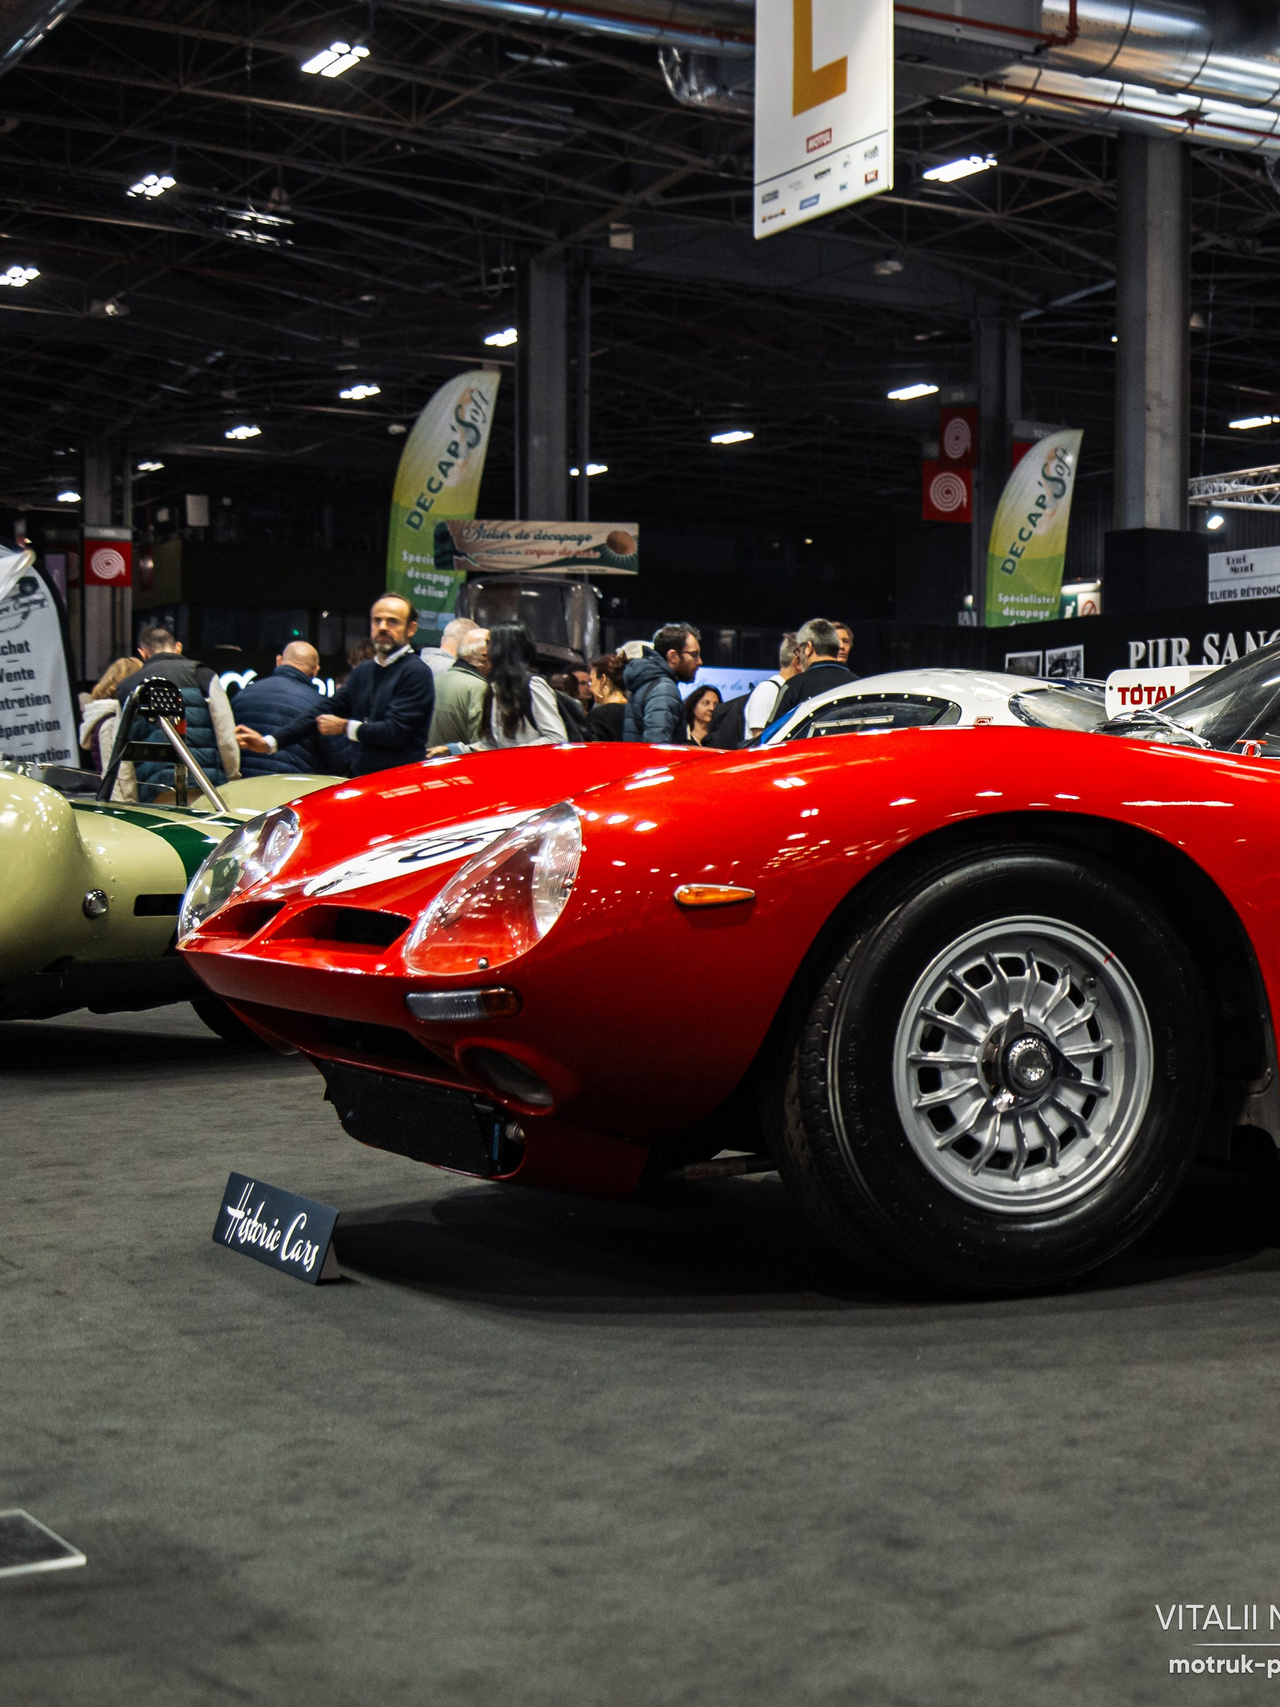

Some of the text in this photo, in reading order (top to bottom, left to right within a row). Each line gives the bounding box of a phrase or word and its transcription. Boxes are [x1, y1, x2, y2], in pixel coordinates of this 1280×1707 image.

[793, 0, 848, 117] L
[1209, 588, 1238, 600] ELIERS
[0, 639, 31, 656] chat
[1128, 637, 1190, 669] PUR
[225, 1182, 319, 1273] Historic Cars
